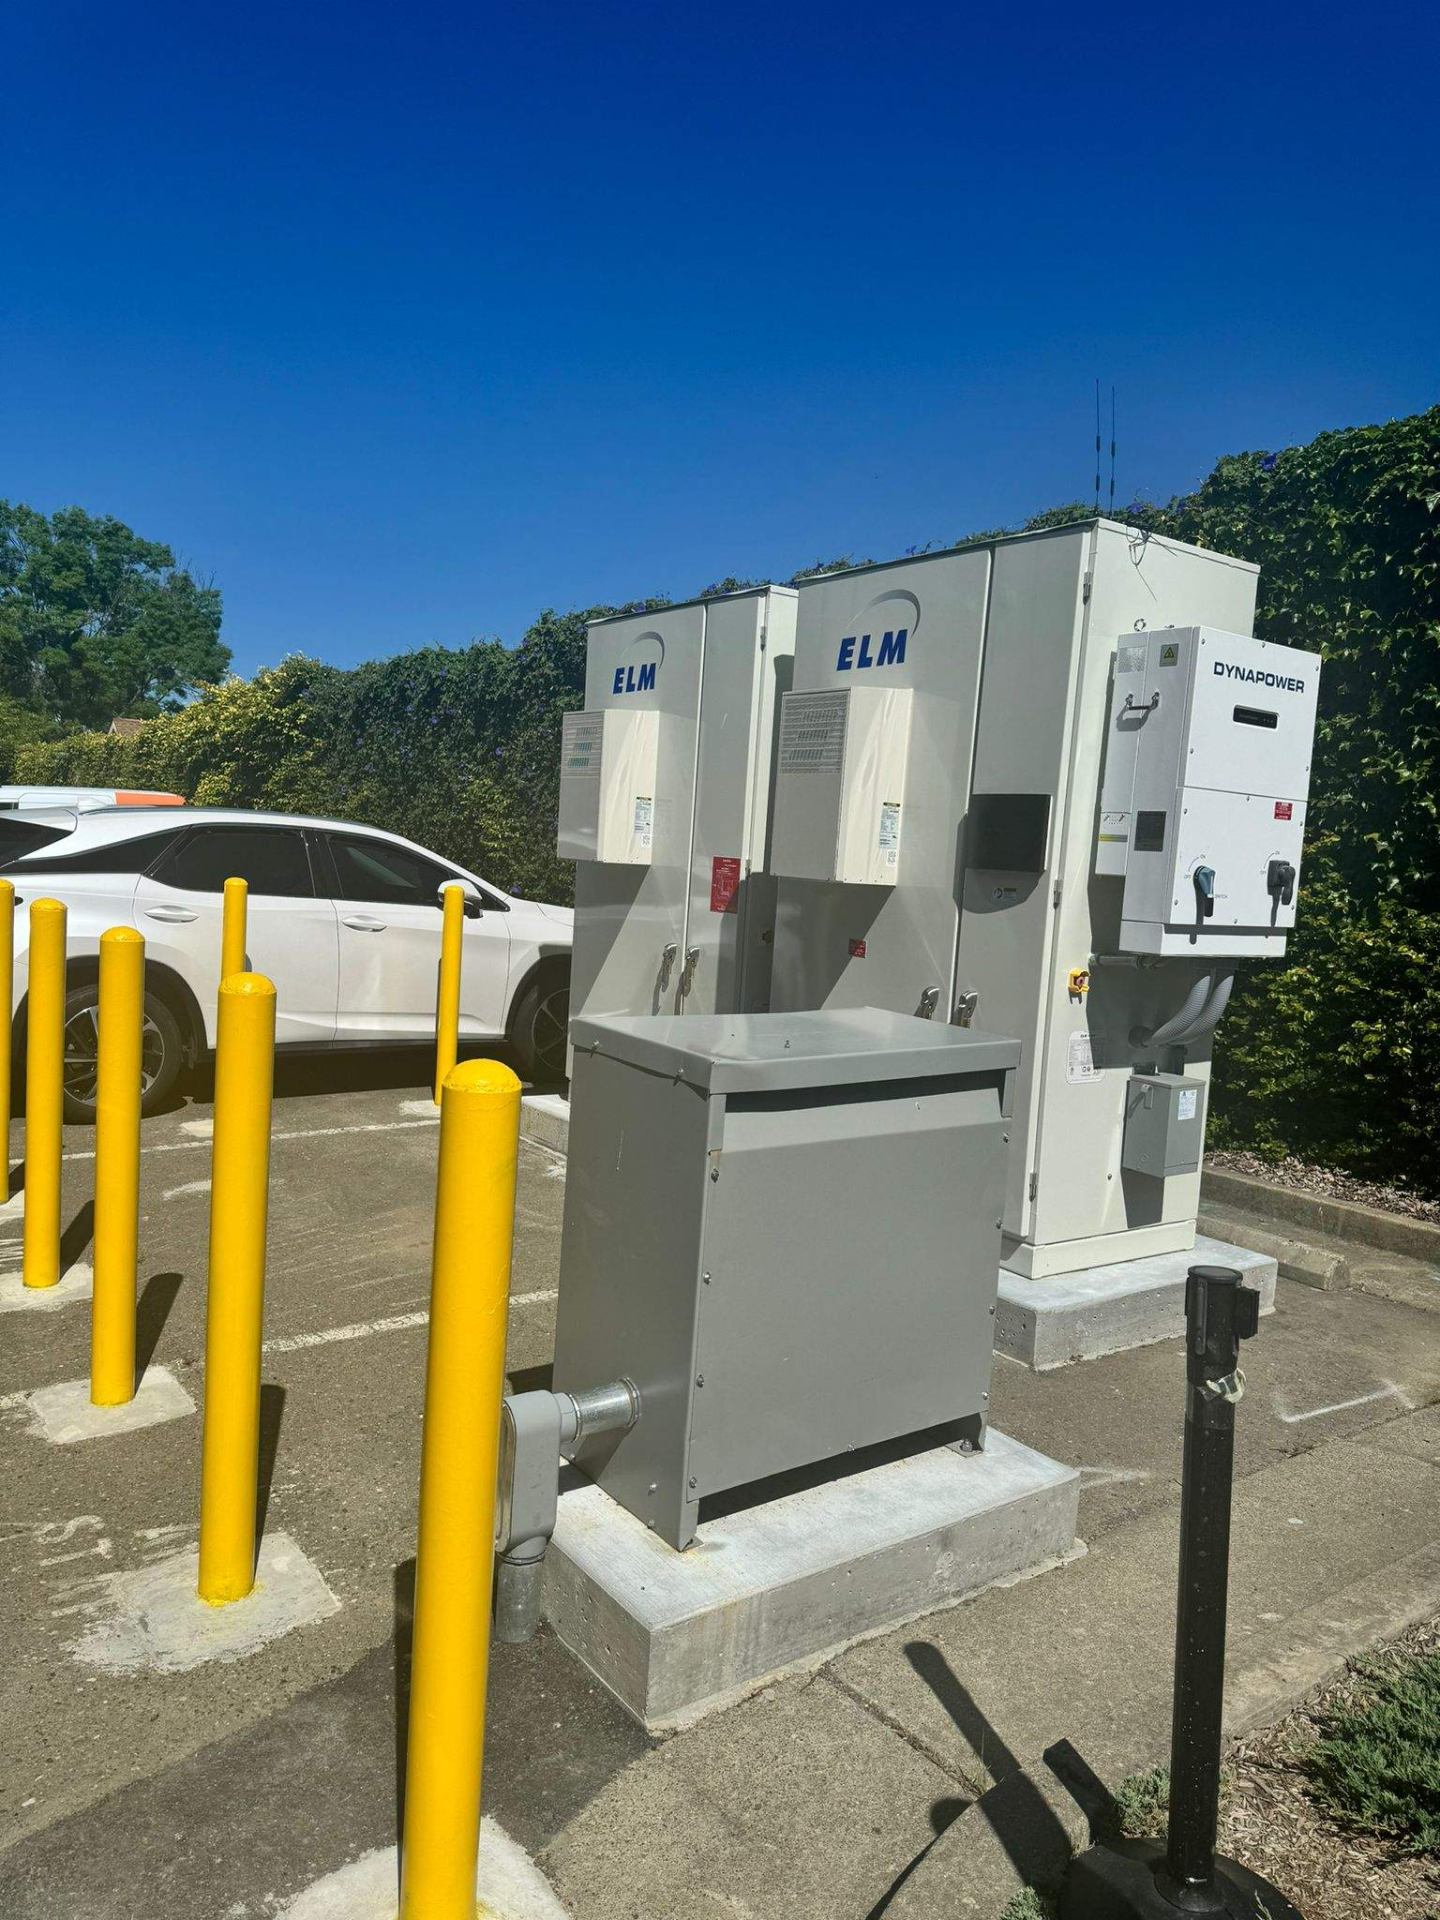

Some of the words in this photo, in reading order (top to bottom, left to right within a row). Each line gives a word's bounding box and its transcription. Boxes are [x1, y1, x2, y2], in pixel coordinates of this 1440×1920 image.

[836, 629, 908, 671] ELM
[612, 662, 657, 694] ELM
[1213, 661, 1305, 694] DYNAPOWER
